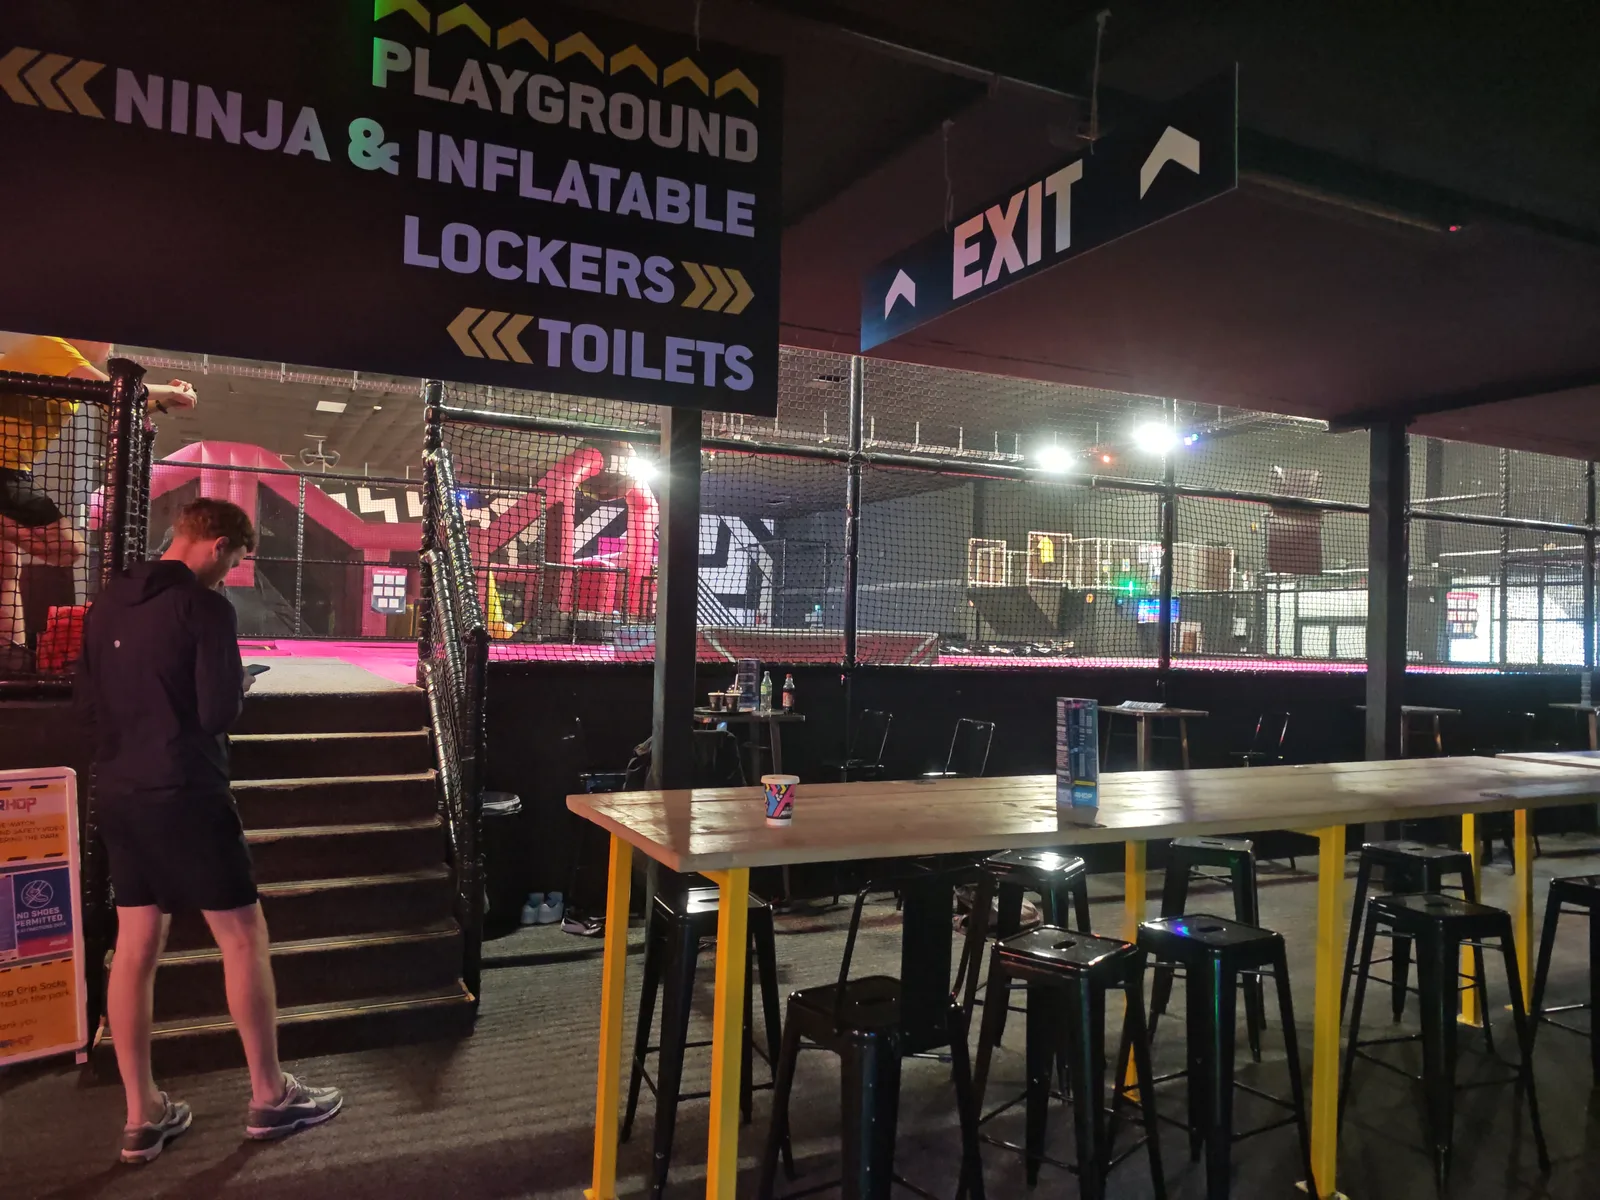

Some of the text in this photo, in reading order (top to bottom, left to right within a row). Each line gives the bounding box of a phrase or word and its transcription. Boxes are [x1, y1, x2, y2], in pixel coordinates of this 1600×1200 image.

[373, 37, 759, 164] PLAYGROUND
[115, 67, 756, 238] NINJA & INFLATABLE
[403, 215, 676, 304] LOCKERS
[953, 158, 1083, 300] EXIT
[538, 318, 755, 392] TOILETS
[15, 913, 63, 927] PERMITTED
[16, 906, 60, 919] NO SHOES
[16, 984, 38, 995] Grip
[39, 980, 67, 990] Socks
